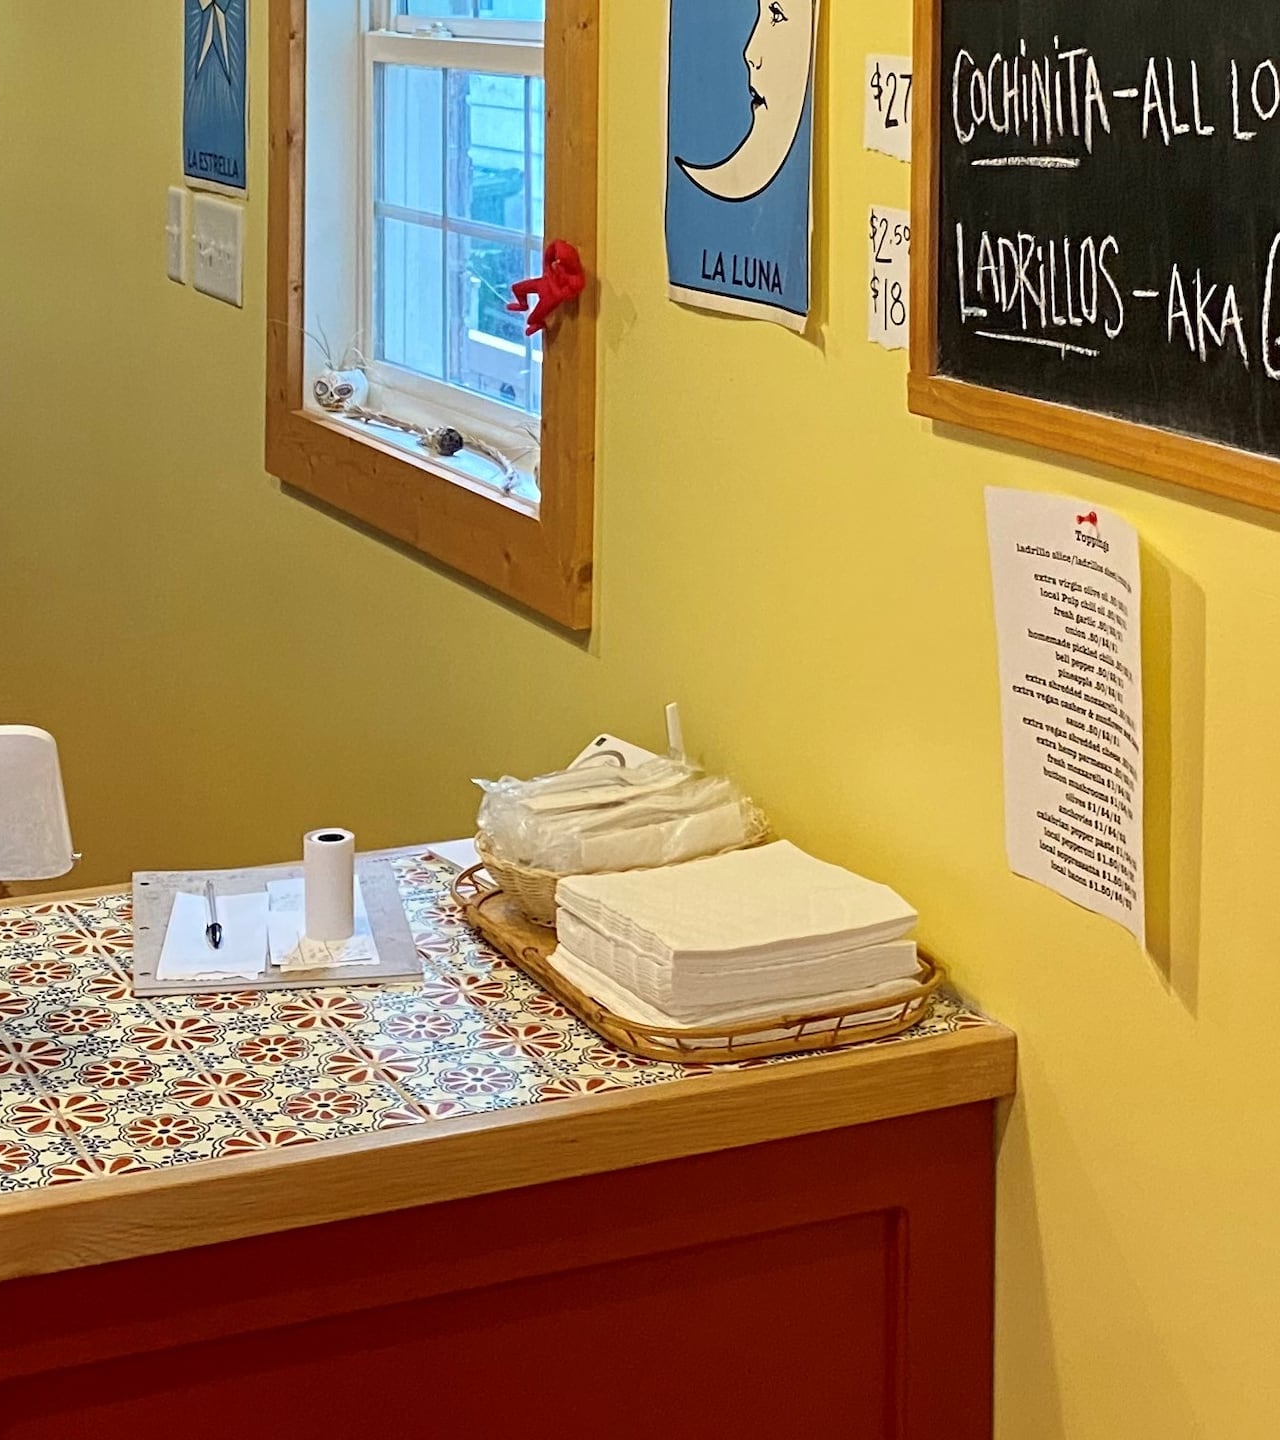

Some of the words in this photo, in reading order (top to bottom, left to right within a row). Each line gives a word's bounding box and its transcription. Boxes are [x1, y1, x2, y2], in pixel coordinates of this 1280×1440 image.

[870, 62, 912, 129] $27
[187, 148, 198, 169] LA
[199, 151, 239, 179] ESTRELLA
[702, 249, 725, 283] LA
[732, 254, 782, 295] LUNA
[870, 268, 906, 331] $18
[1166, 263, 1249, 368] AKA
[1033, 572, 1057, 586] extra
[1039, 587, 1060, 602] local
[1027, 628, 1071, 650] homemade
